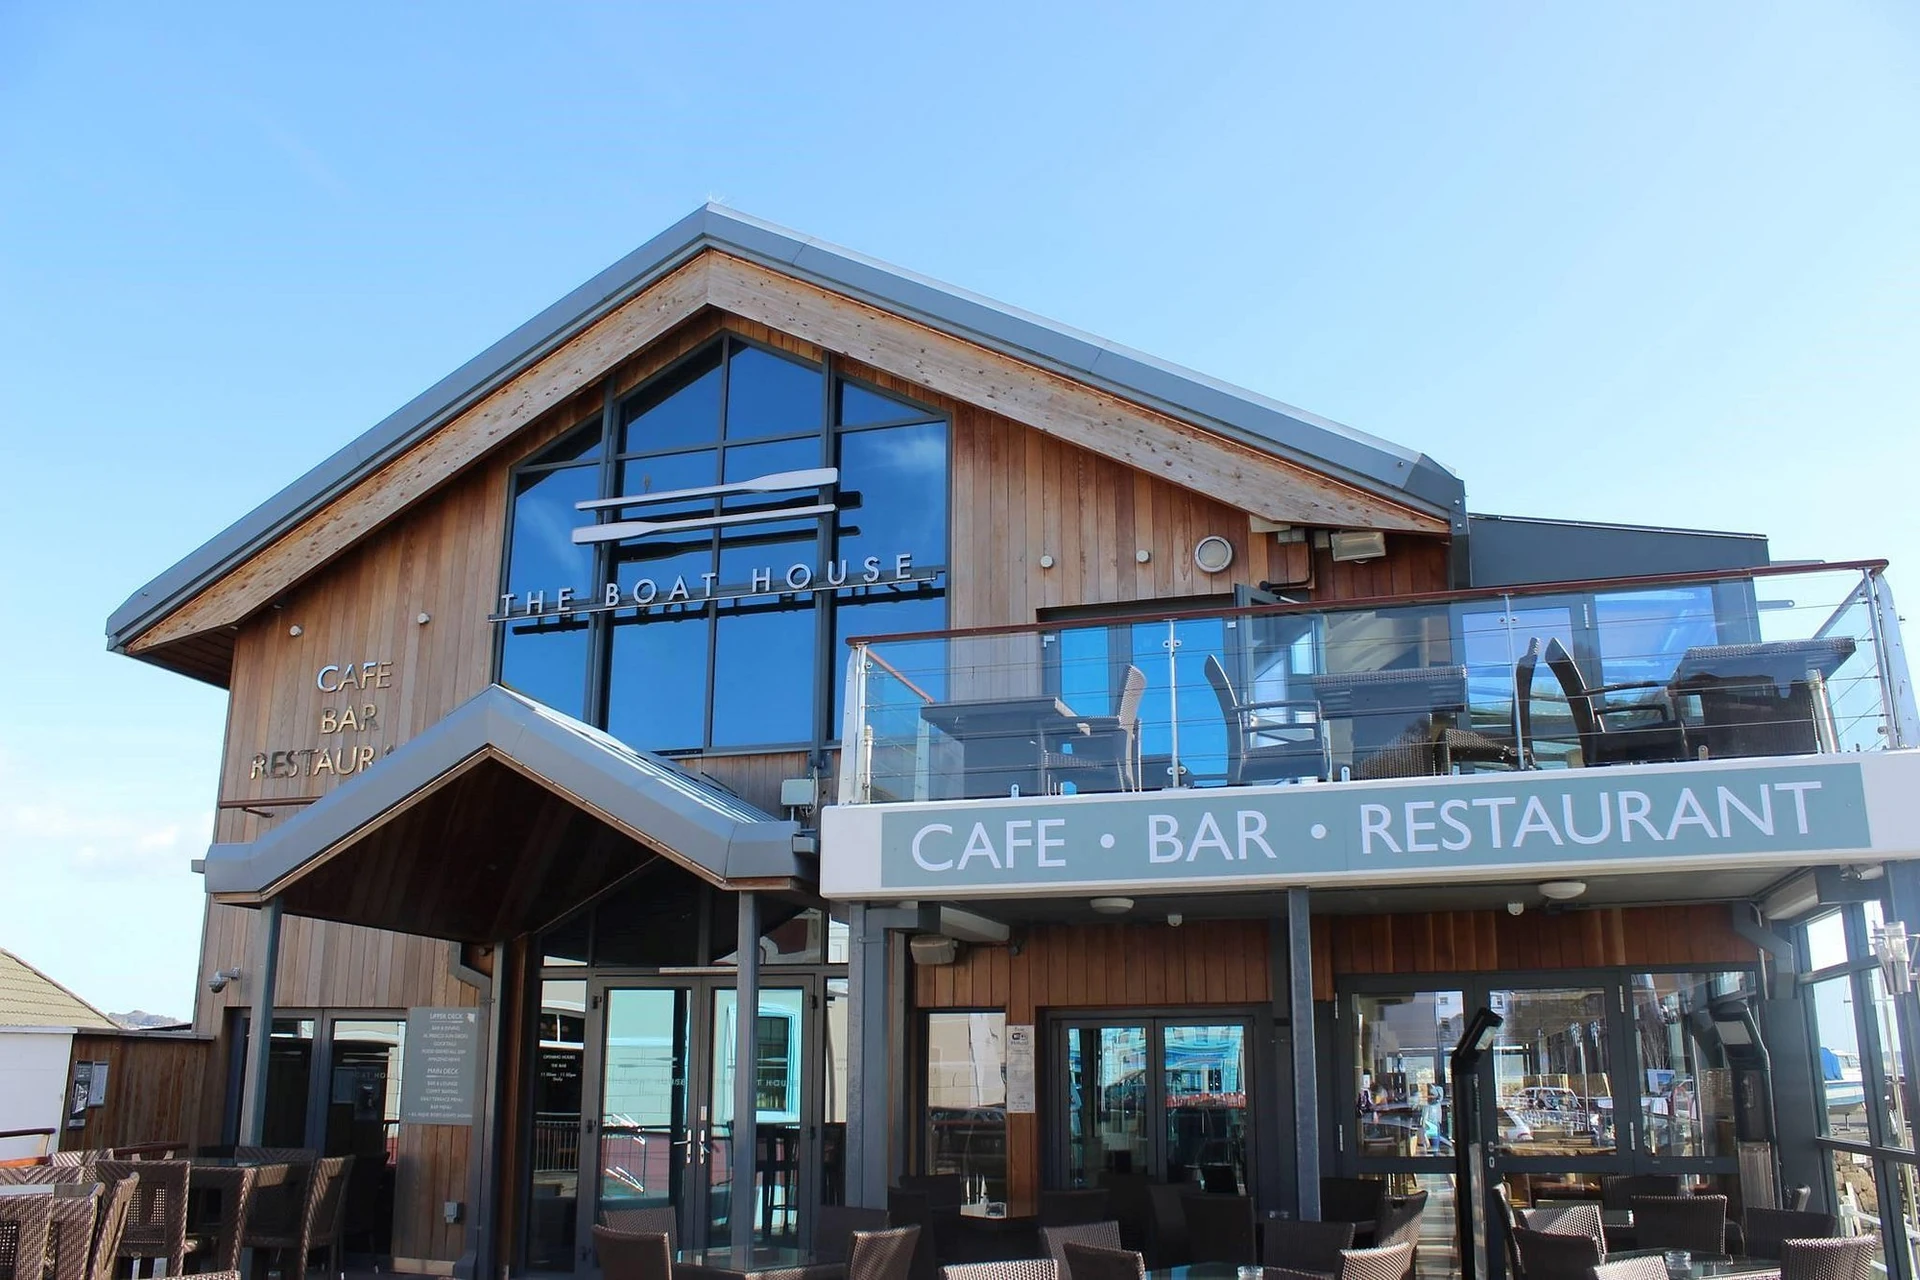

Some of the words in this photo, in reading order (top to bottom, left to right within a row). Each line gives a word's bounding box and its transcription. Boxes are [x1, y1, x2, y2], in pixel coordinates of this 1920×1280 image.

[501, 588, 573, 617] THE
[604, 571, 718, 608] BOAT
[751, 553, 914, 594] HOUSE
[317, 661, 393, 693] CAFE
[321, 704, 379, 734] BAR
[251, 744, 394, 779] RESTAUR
[911, 818, 1067, 872] CAFE
[1147, 810, 1278, 864] BAR
[1359, 781, 1822, 855] RESTAURANT
